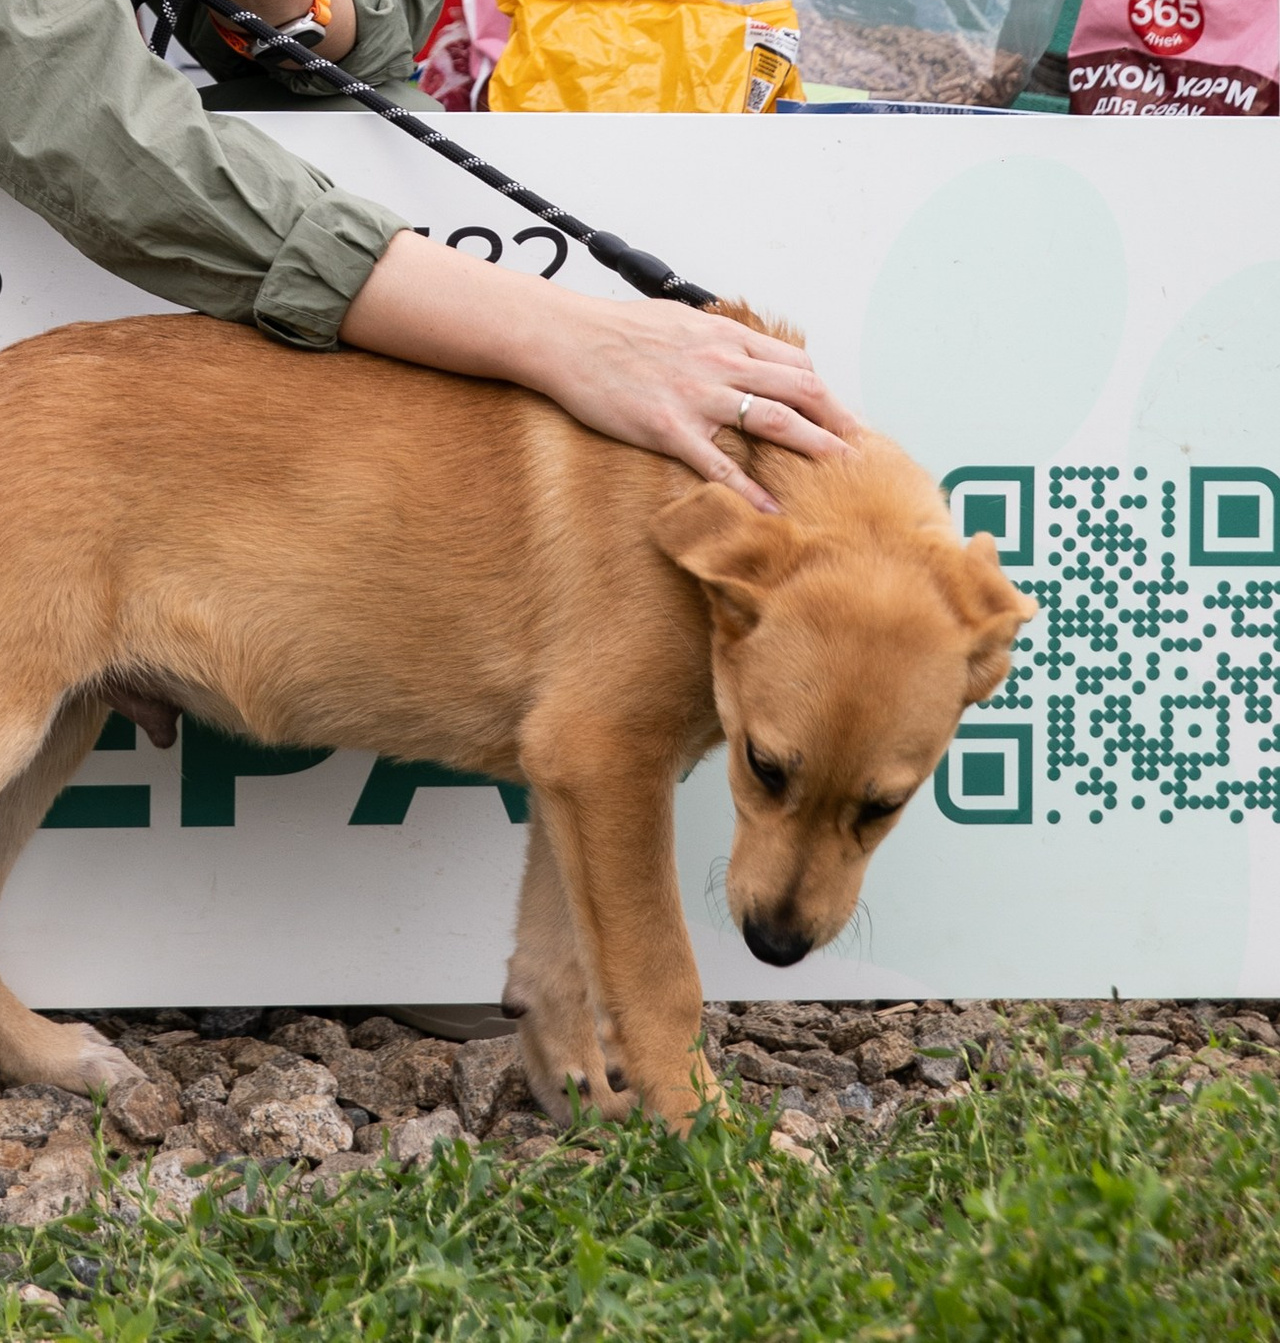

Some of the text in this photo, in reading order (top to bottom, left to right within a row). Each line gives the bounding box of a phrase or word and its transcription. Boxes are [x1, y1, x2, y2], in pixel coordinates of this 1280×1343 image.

[1069, 62, 1259, 112] СУХОЙ КОРМ
[1092, 96, 1138, 116] ДЛЯ
